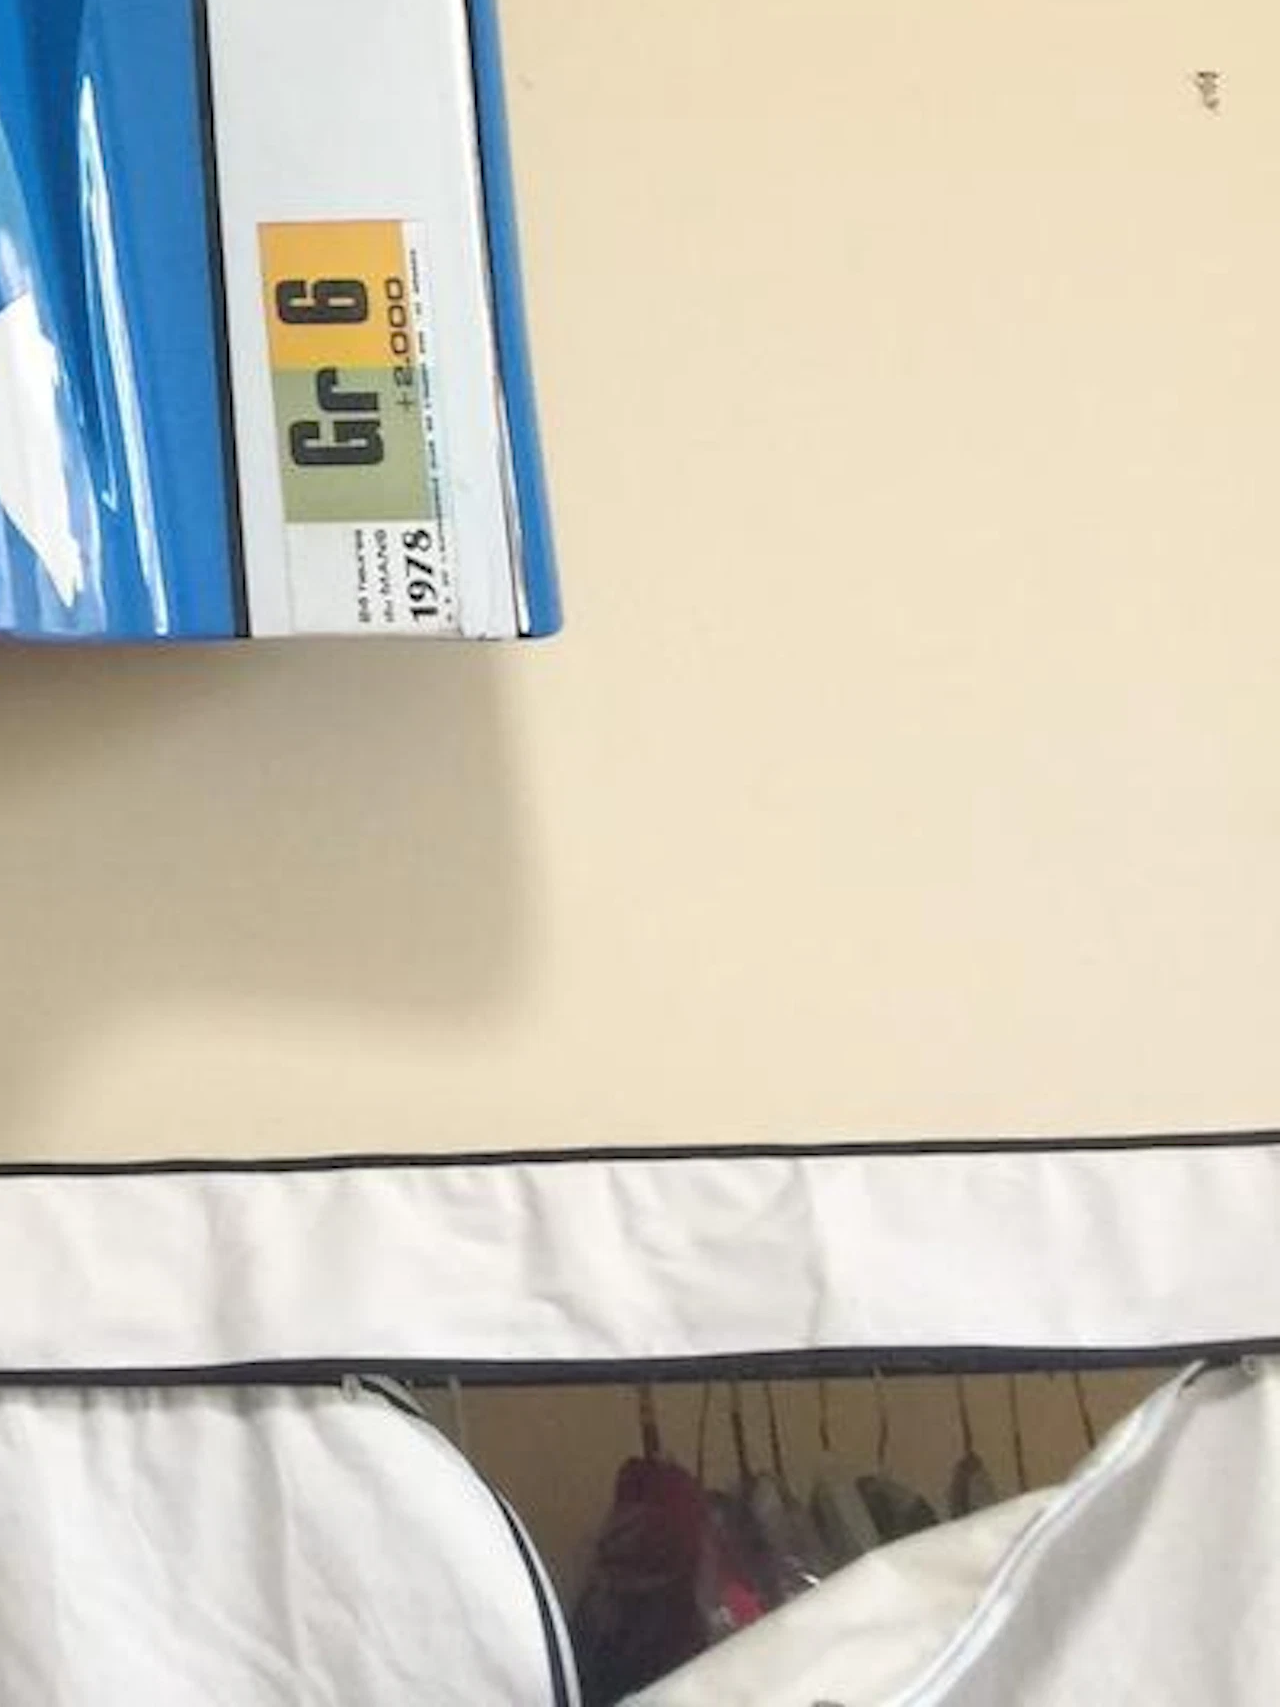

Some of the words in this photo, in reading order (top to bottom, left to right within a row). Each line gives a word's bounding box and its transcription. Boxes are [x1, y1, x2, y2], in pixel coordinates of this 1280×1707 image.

[275, 278, 370, 326] 6
[288, 366, 385, 468] Gr
[400, 529, 439, 624] 1978
